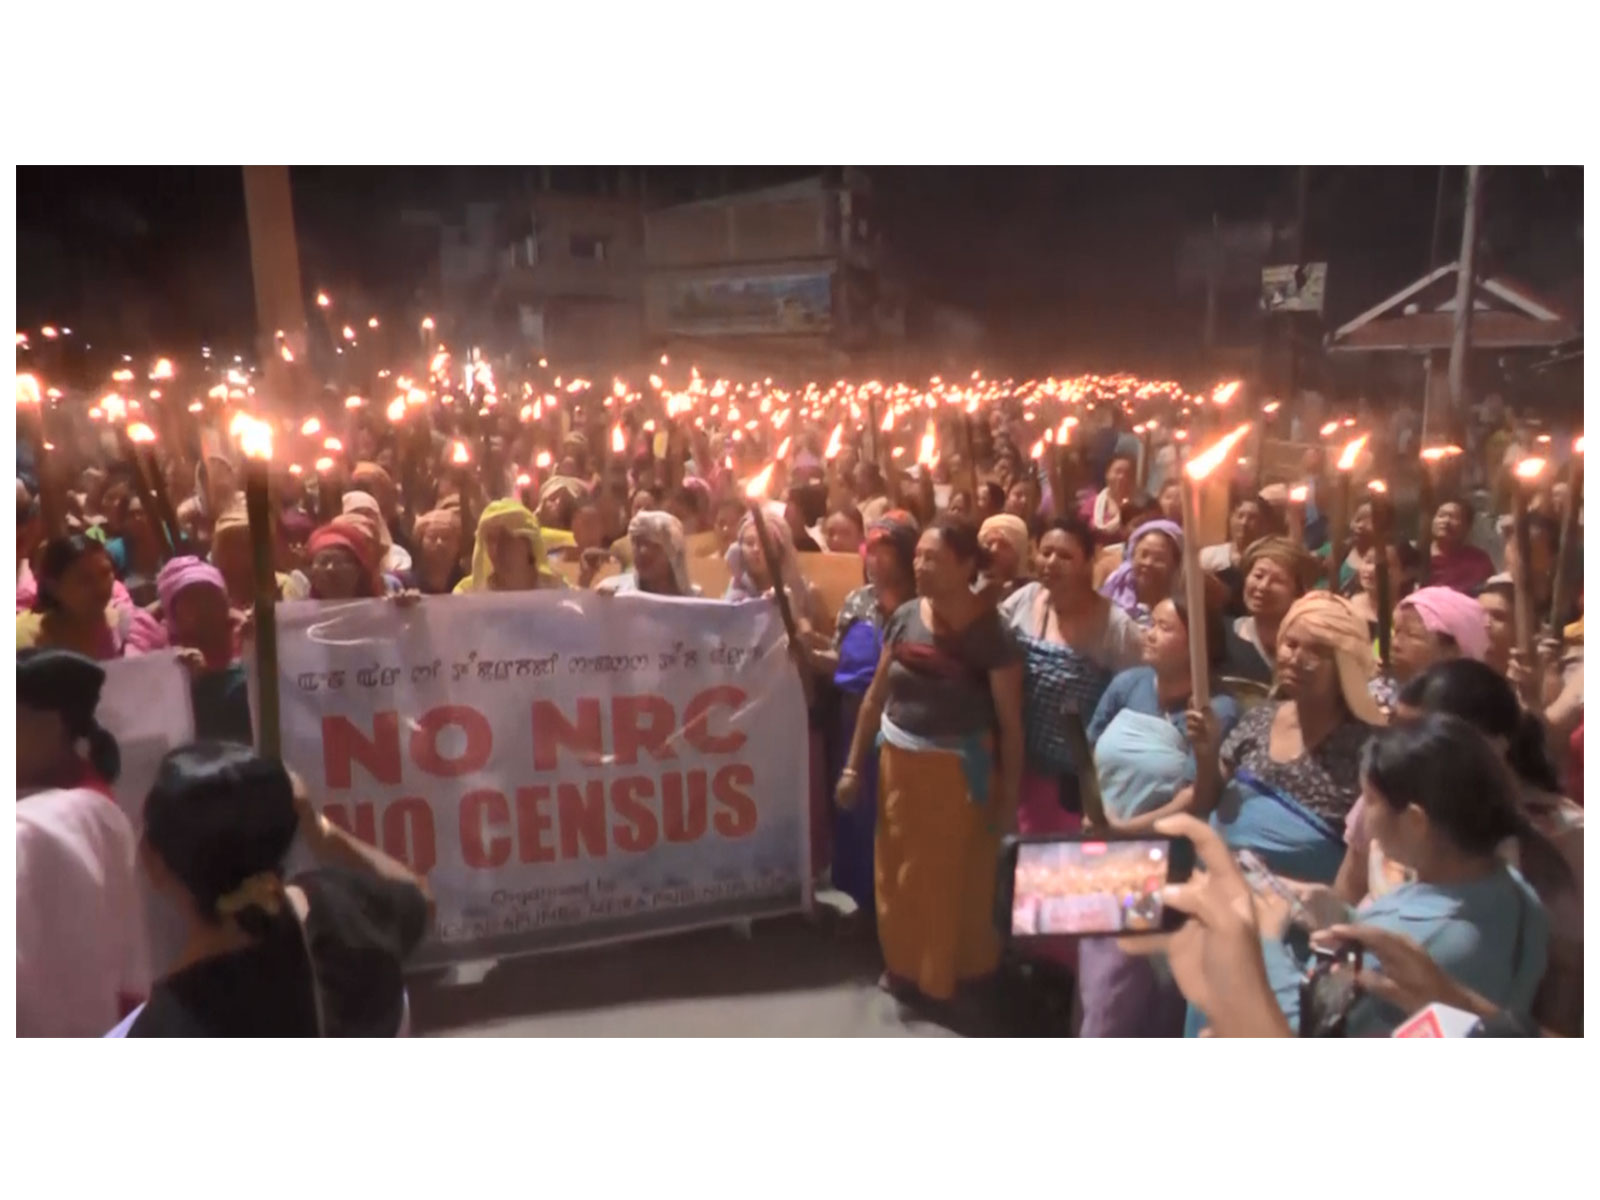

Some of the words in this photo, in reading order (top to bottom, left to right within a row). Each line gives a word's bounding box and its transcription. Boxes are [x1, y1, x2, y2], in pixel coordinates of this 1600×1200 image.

[322, 705, 493, 789] NO
[531, 685, 749, 770] NRC
[459, 764, 758, 869] CENSUS
